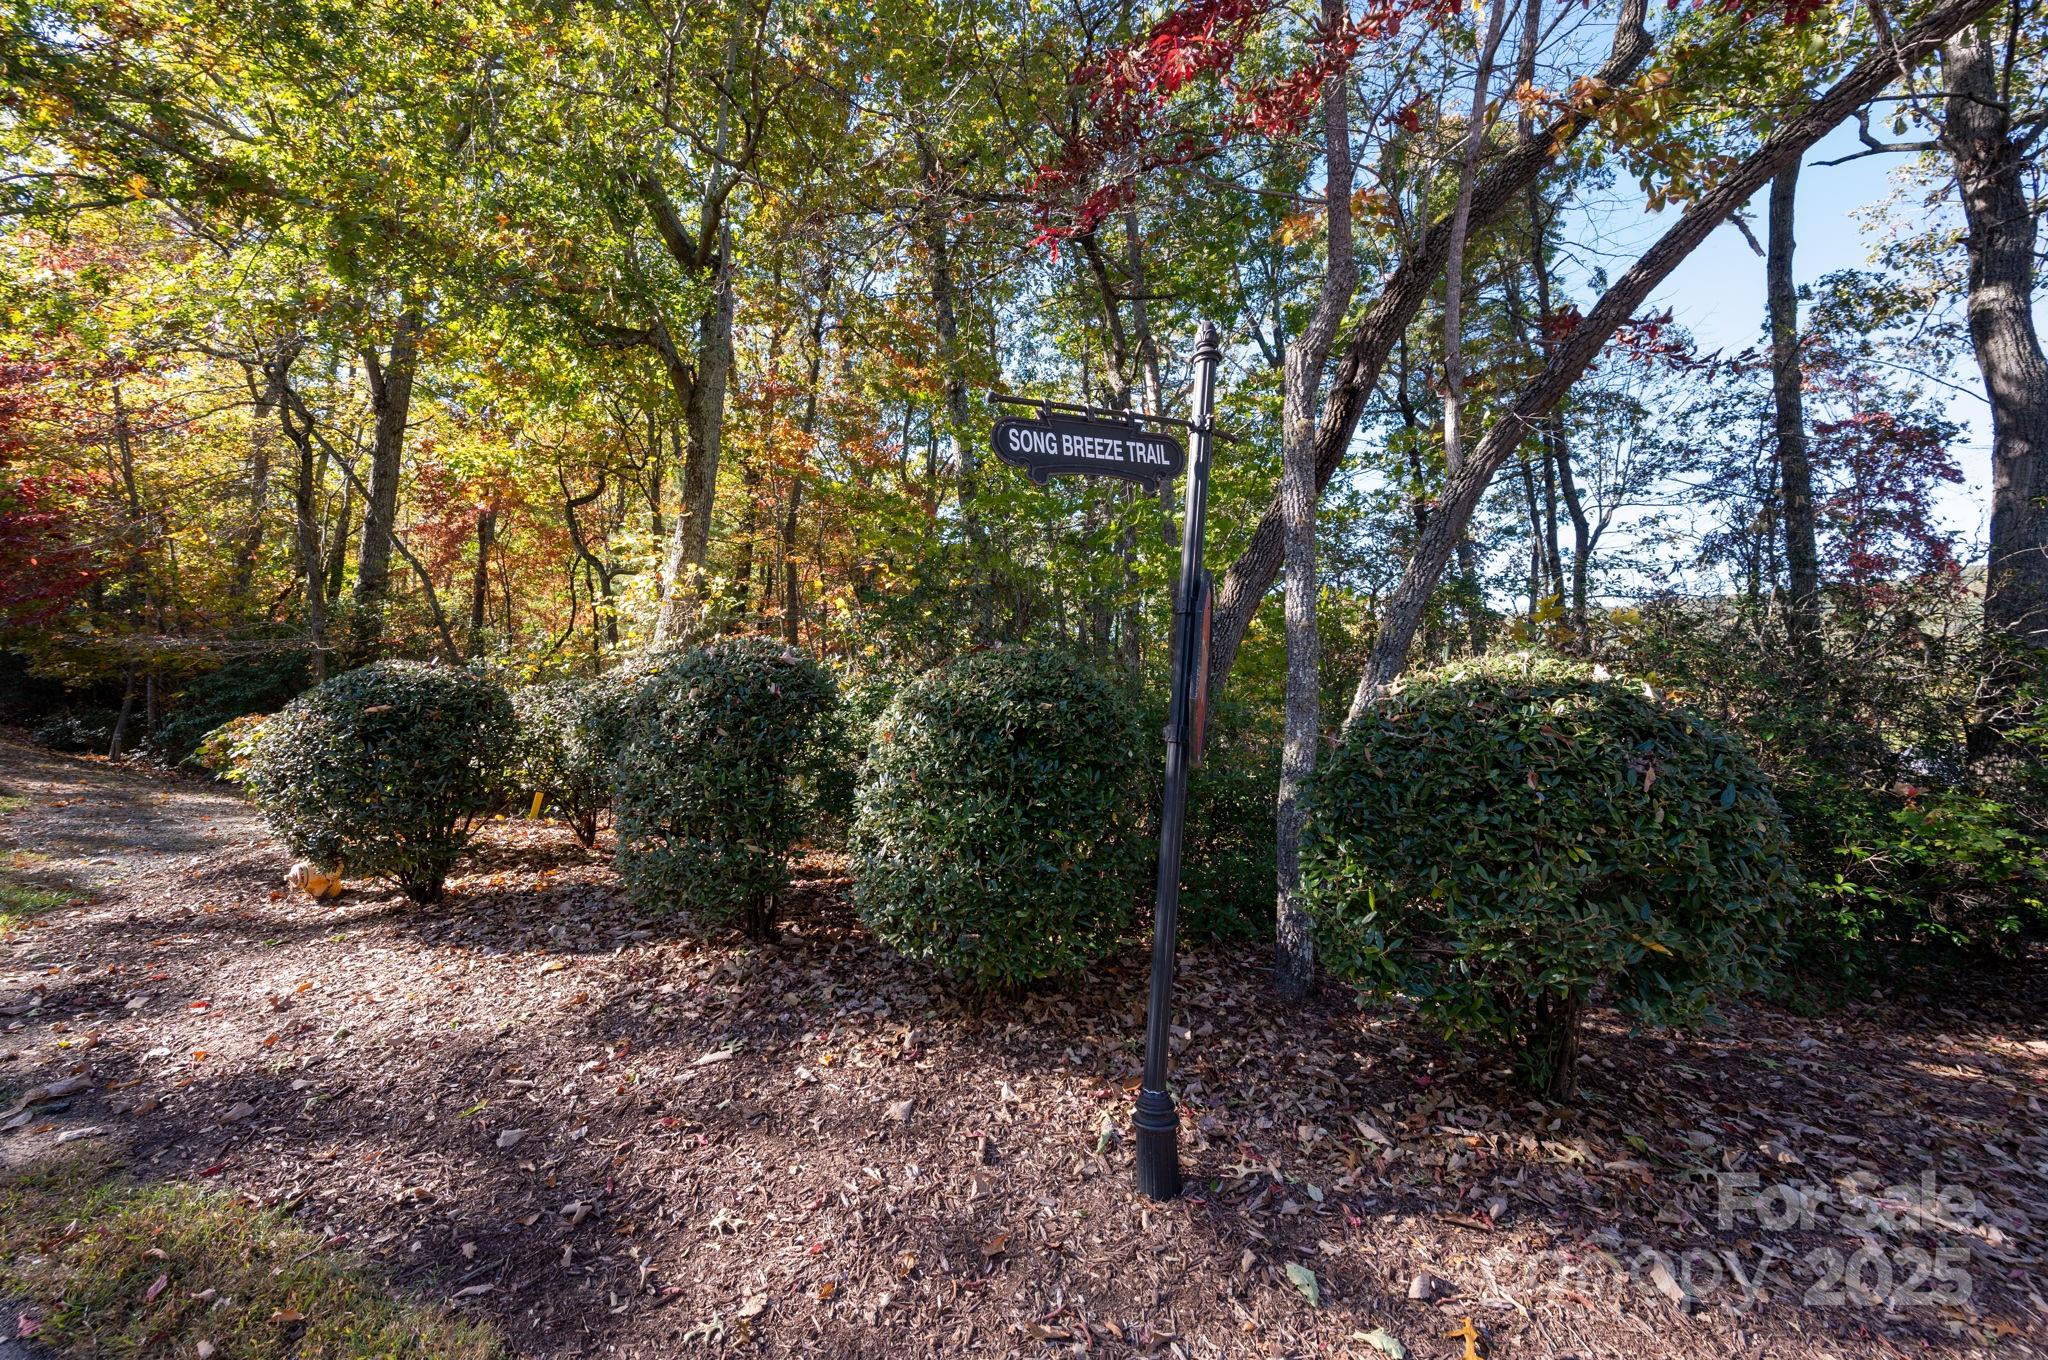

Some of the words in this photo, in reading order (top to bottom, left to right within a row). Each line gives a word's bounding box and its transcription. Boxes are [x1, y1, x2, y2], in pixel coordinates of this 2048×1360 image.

[1008, 428, 1058, 455] SONG
[1062, 434, 1124, 461] BREEZE
[1126, 441, 1170, 465] TRAIL
